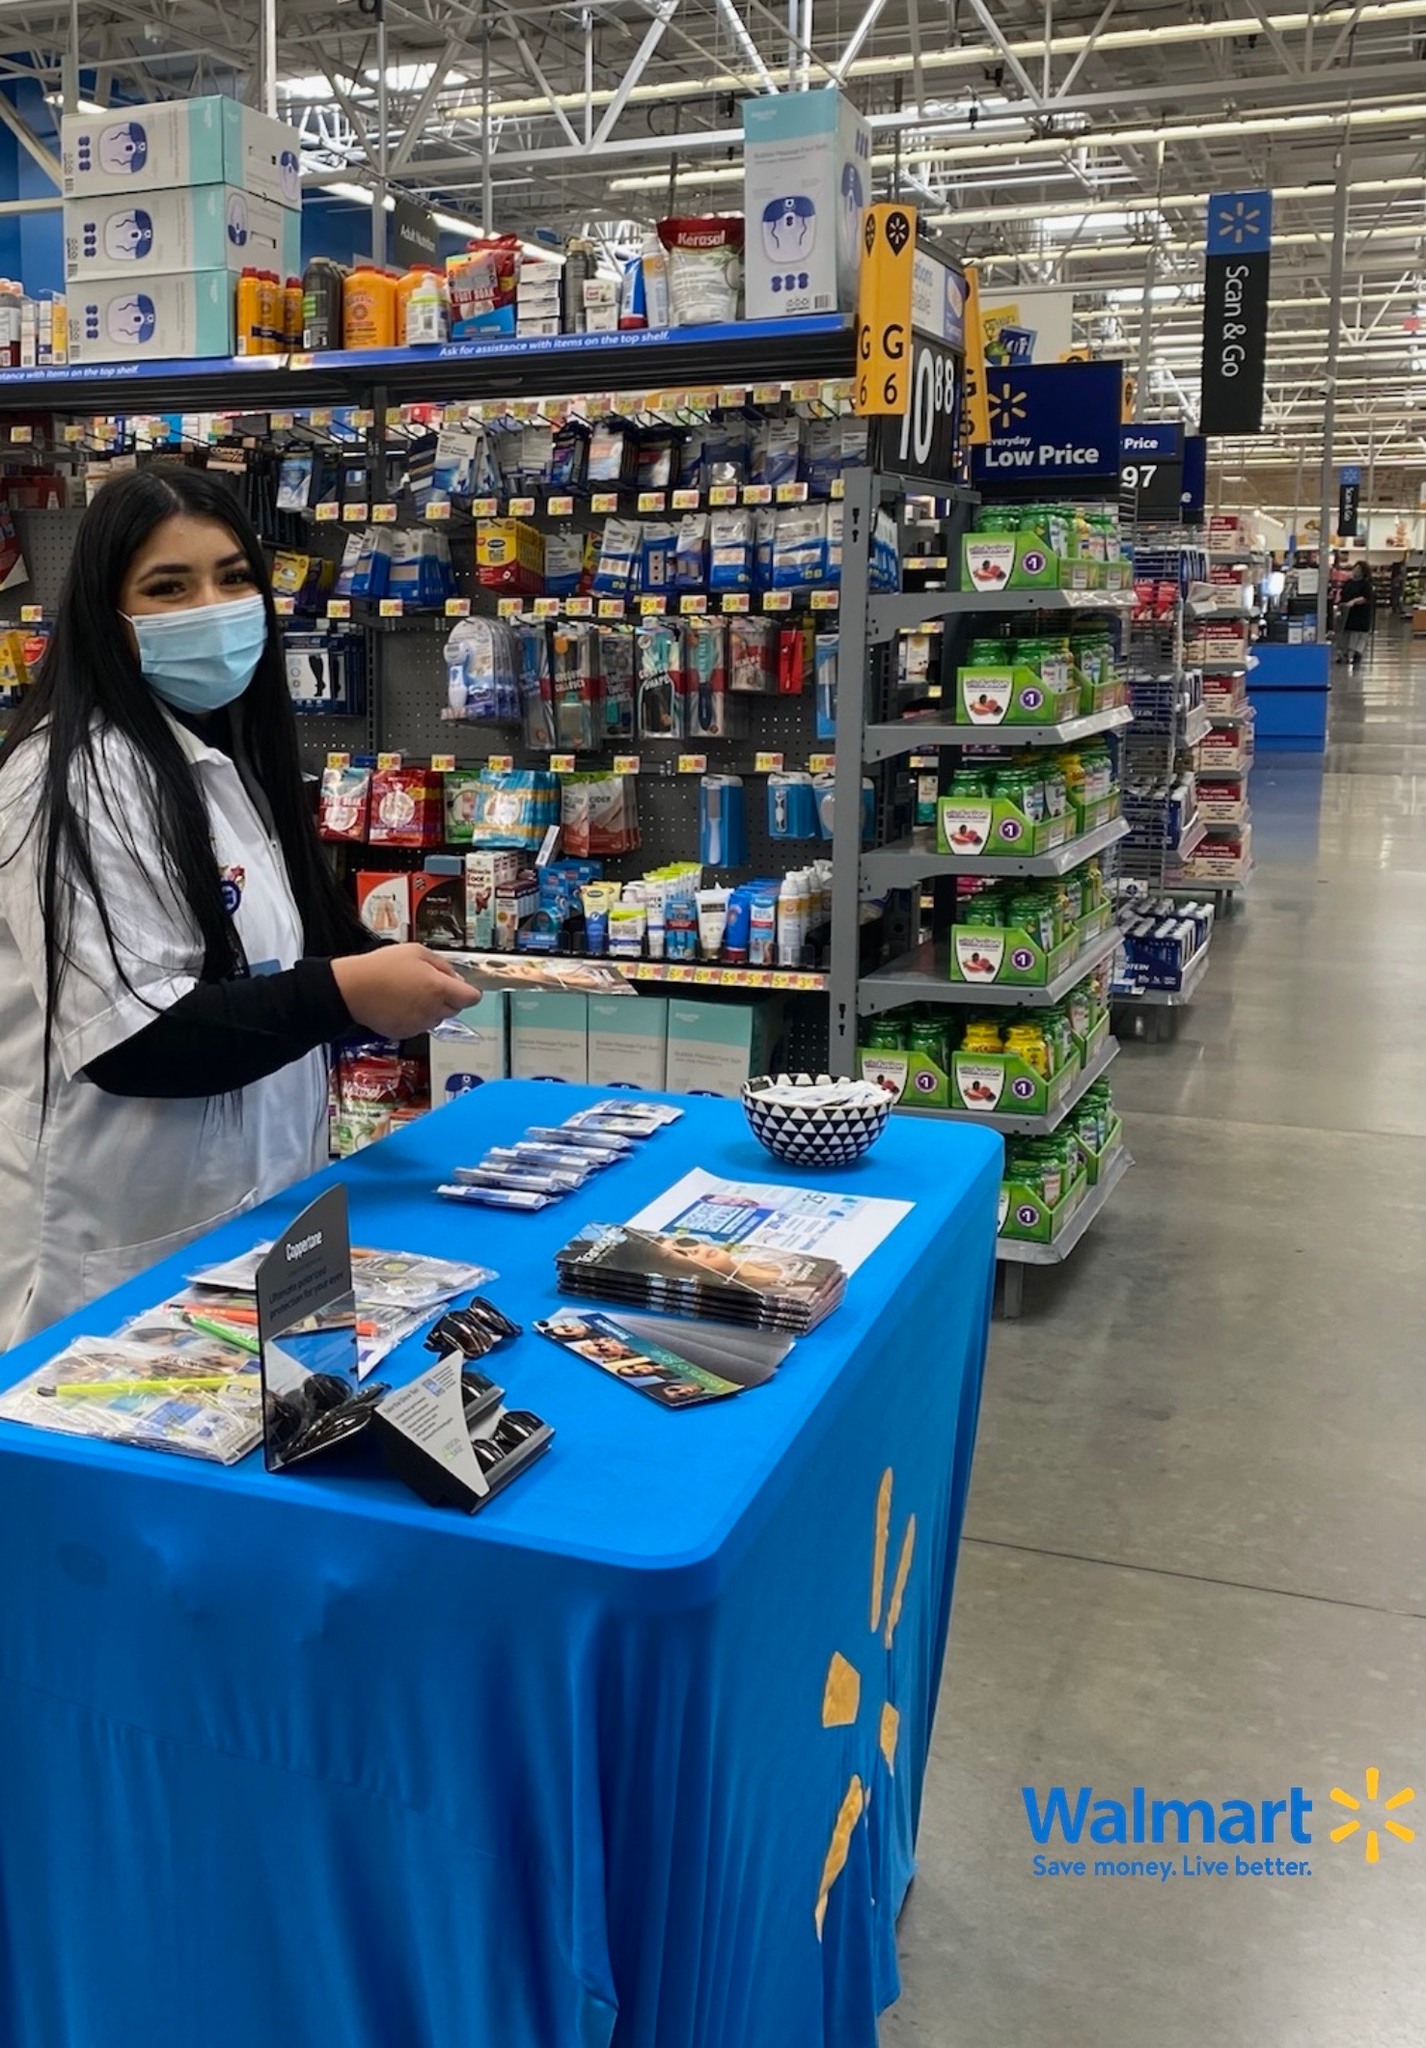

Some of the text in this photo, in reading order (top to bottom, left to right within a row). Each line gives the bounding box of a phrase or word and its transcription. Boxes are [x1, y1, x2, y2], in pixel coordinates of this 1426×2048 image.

[677, 229, 726, 247] Kerasal
[1222, 265, 1250, 377] Scan & Go
[440, 346, 458, 356] Ask
[459, 345, 475, 355] for
[475, 342, 528, 354] assistance
[528, 339, 551, 350] with
[553, 337, 583, 349] items
[584, 337, 599, 346] on
[601, 334, 619, 345] the
[620, 335, 640, 345] top
[882, 323, 905, 360] G
[26, 369, 46, 379] with
[46, 368, 70, 378] items
[71, 369, 83, 378] on
[84, 365, 98, 376] the
[99, 366, 115, 377] top
[883, 372, 898, 406] 6
[987, 435, 1032, 447] veryday
[1124, 437, 1159, 450] Price
[985, 443, 1100, 467] Low Price
[286, 1231, 322, 1261] Coppertone
